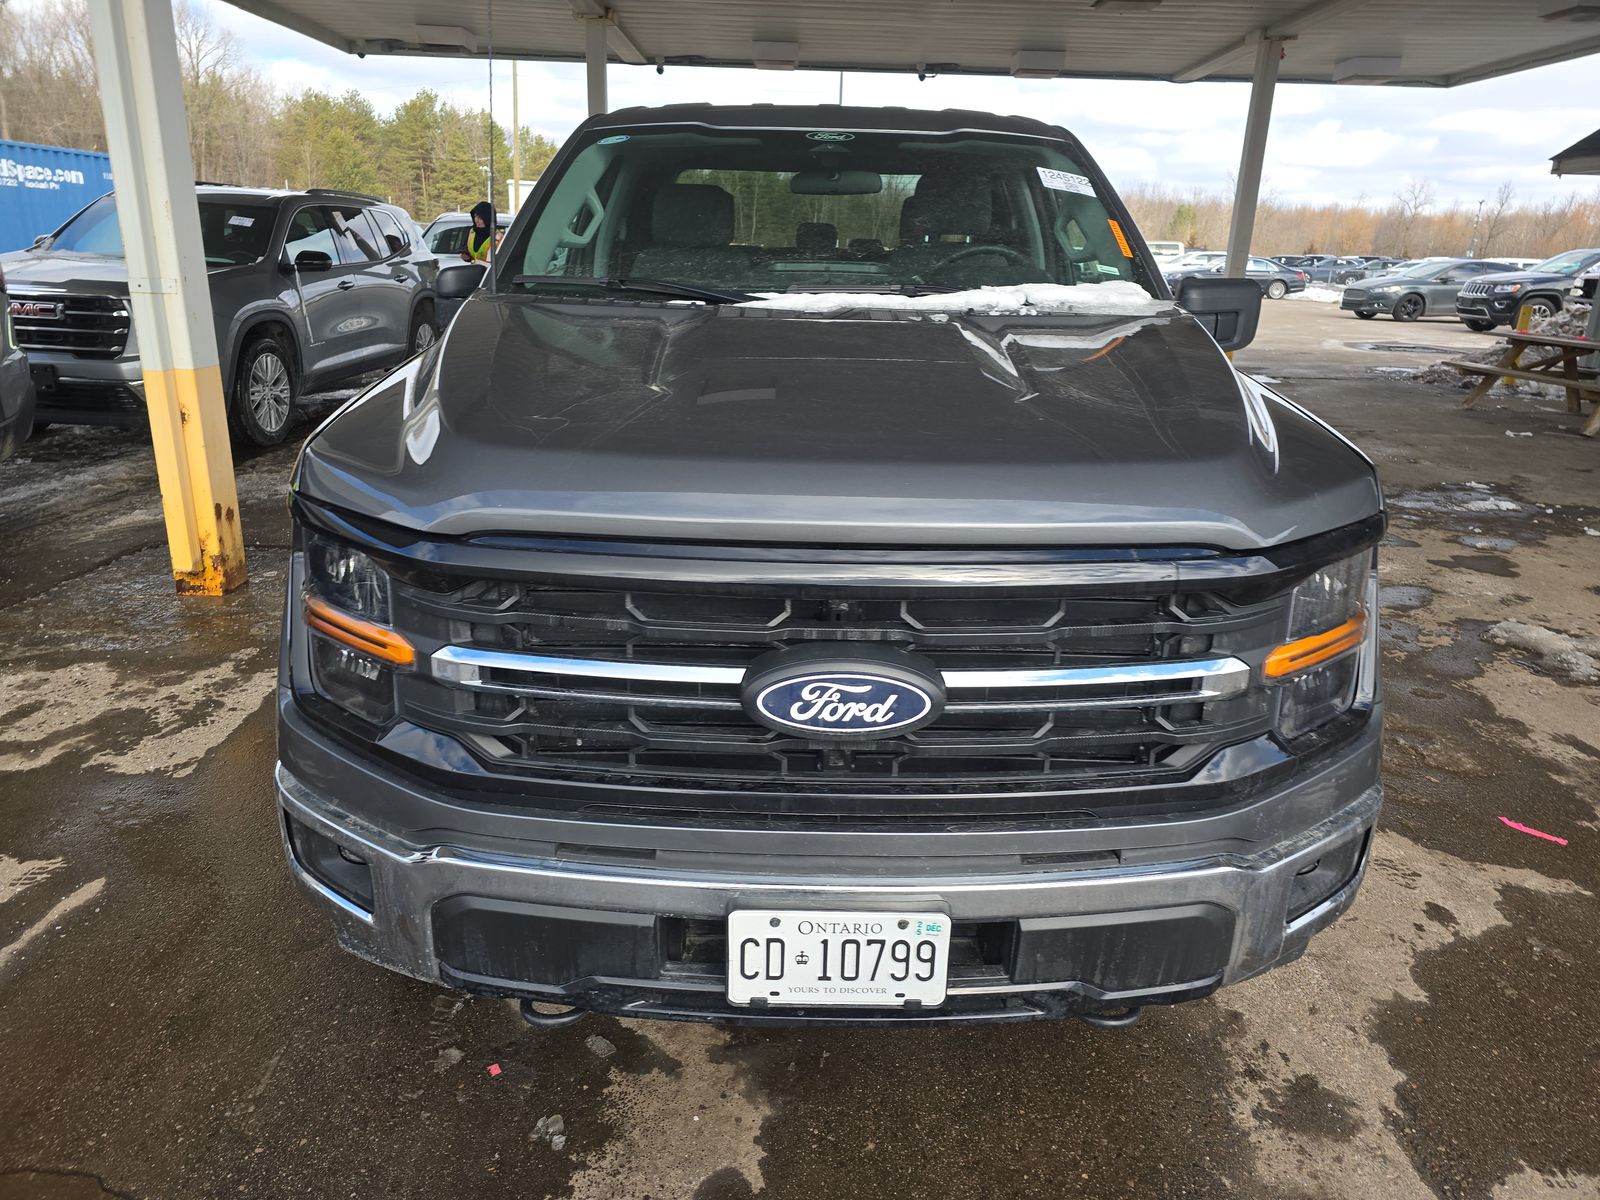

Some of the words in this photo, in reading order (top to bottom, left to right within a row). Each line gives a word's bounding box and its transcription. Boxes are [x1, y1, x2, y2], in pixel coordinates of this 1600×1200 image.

[789, 682, 899, 723] Ford
[740, 937, 786, 980] CD
[817, 938, 937, 982] 10799
[788, 986, 820, 994] YOURS
[839, 986, 888, 995] DISCOVER
